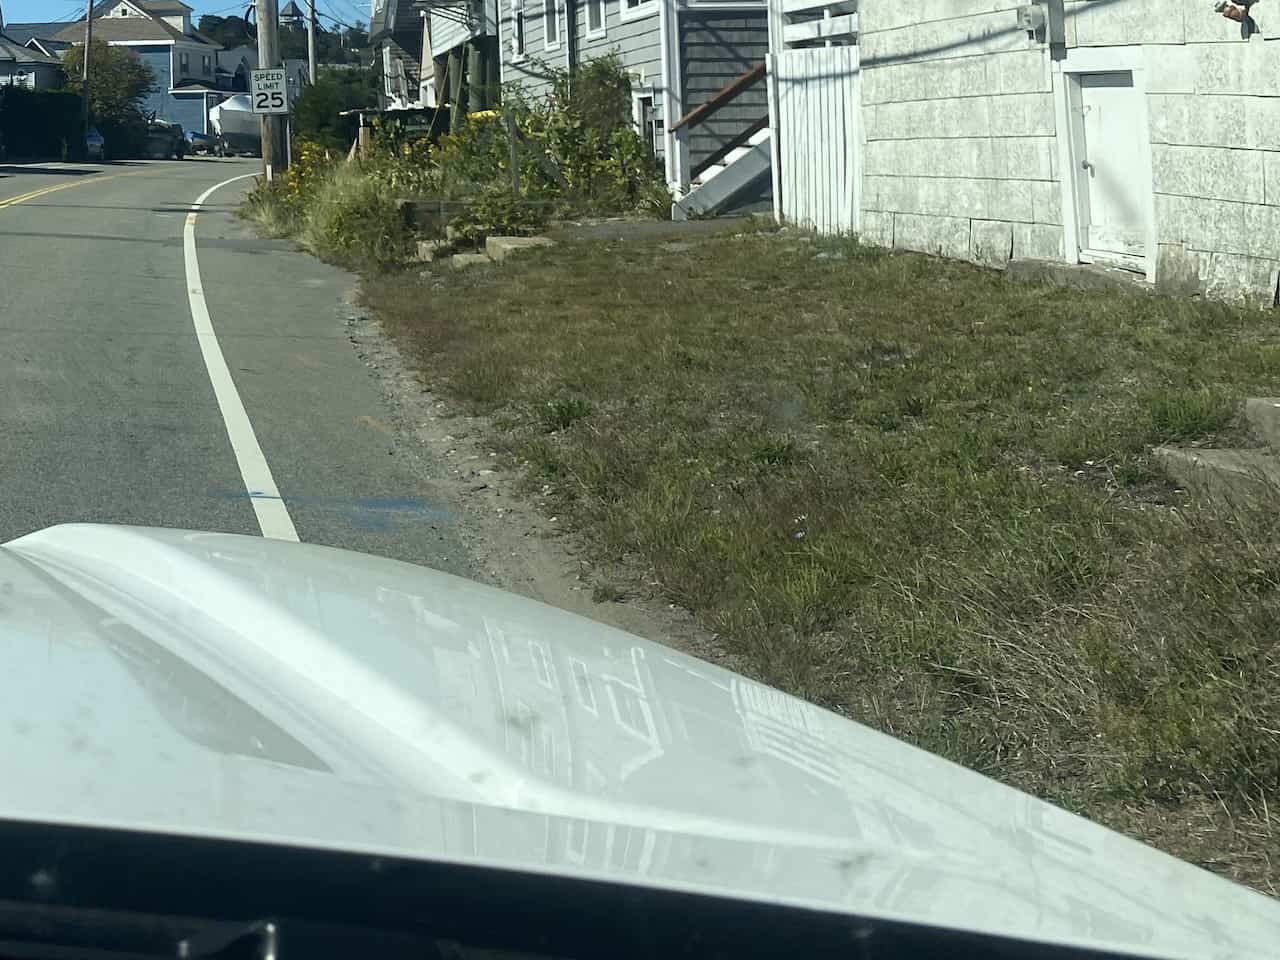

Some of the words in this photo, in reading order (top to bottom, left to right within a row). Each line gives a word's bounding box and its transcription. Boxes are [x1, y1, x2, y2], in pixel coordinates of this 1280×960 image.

[254, 73, 283, 81] SPEED
[257, 82, 280, 90] LIMIT
[255, 92, 284, 108] 25
